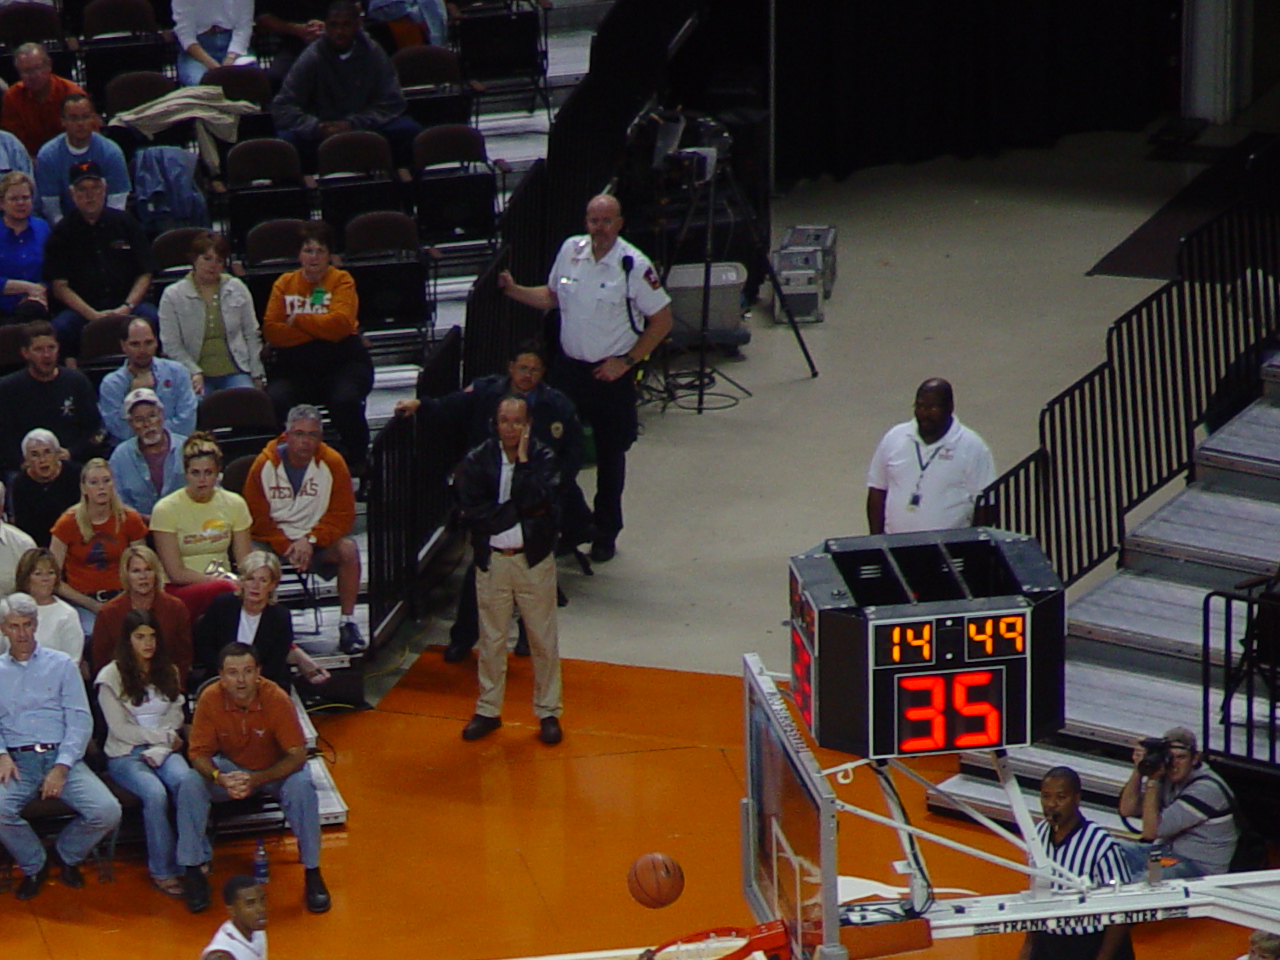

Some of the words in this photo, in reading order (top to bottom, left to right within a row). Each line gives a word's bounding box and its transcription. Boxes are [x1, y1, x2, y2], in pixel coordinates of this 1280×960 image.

[283, 293, 333, 316] TEXS
[898, 670, 1001, 752] 35
[1003, 919, 1051, 934] FRANK
[1056, 914, 1101, 930] ERWIN
[1108, 908, 1160, 925] CNTER
